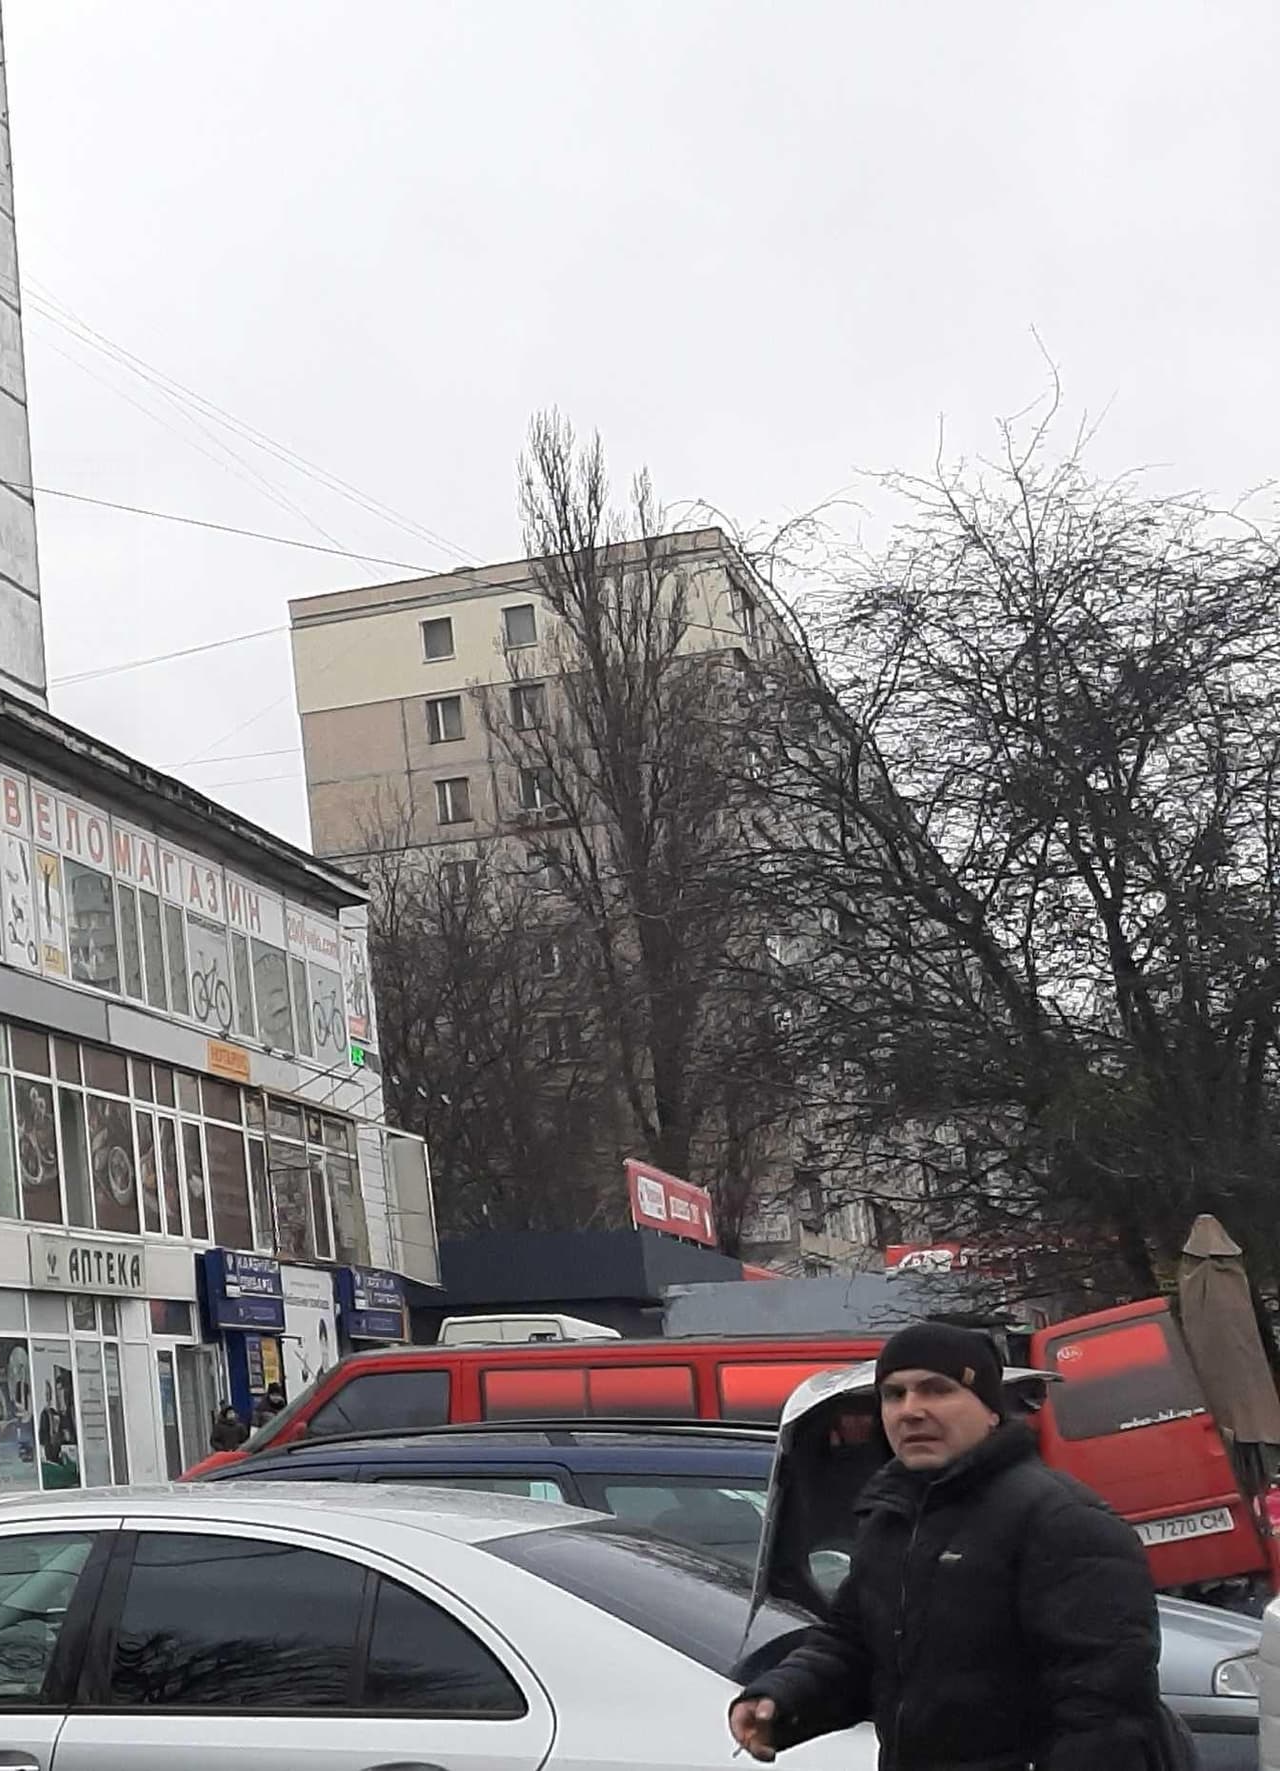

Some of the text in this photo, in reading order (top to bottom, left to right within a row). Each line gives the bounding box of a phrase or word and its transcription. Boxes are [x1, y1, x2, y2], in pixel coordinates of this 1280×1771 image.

[2, 778, 263, 934] ВЕЛОМАГАЗИН
[69, 1248, 141, 1289] АПТЕКА
[1159, 1519, 1197, 1539] 7270
[1200, 1511, 1228, 1530] CM
